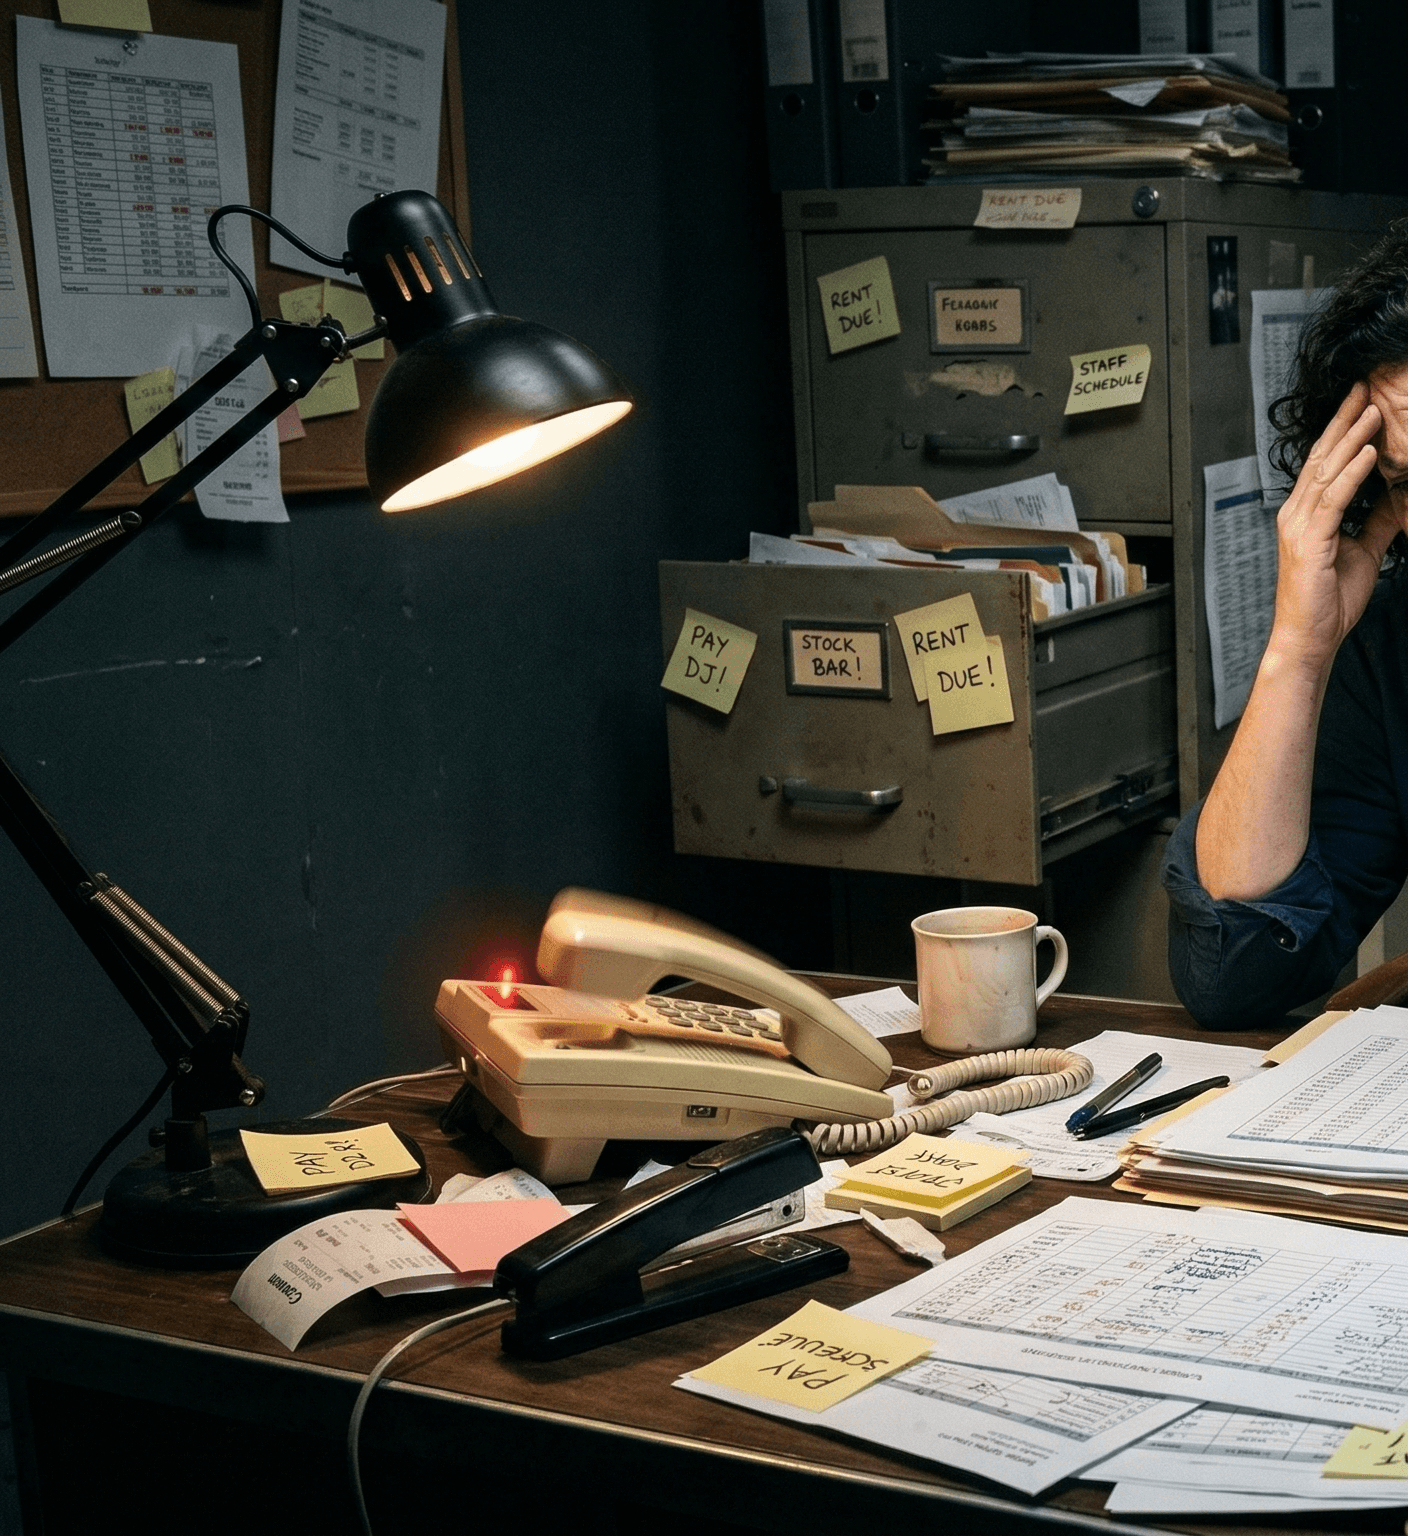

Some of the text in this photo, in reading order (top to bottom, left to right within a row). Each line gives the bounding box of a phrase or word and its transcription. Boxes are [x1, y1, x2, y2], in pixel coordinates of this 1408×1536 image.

[1033, 192, 1067, 207] DUE
[830, 283, 874, 311] RENT
[839, 300, 882, 335] DUE!
[1080, 353, 1128, 377] STAFF
[1074, 371, 1144, 396] SCHEDULE
[690, 624, 730, 657] PAY
[801, 634, 857, 654] STOCK
[911, 622, 973, 656] RENT
[684, 657, 728, 692] DJ!
[811, 656, 863, 680] BAR!
[939, 655, 996, 694] DUE!
[288, 1151, 336, 1176] PAY
[757, 1359, 850, 1390] PAY
